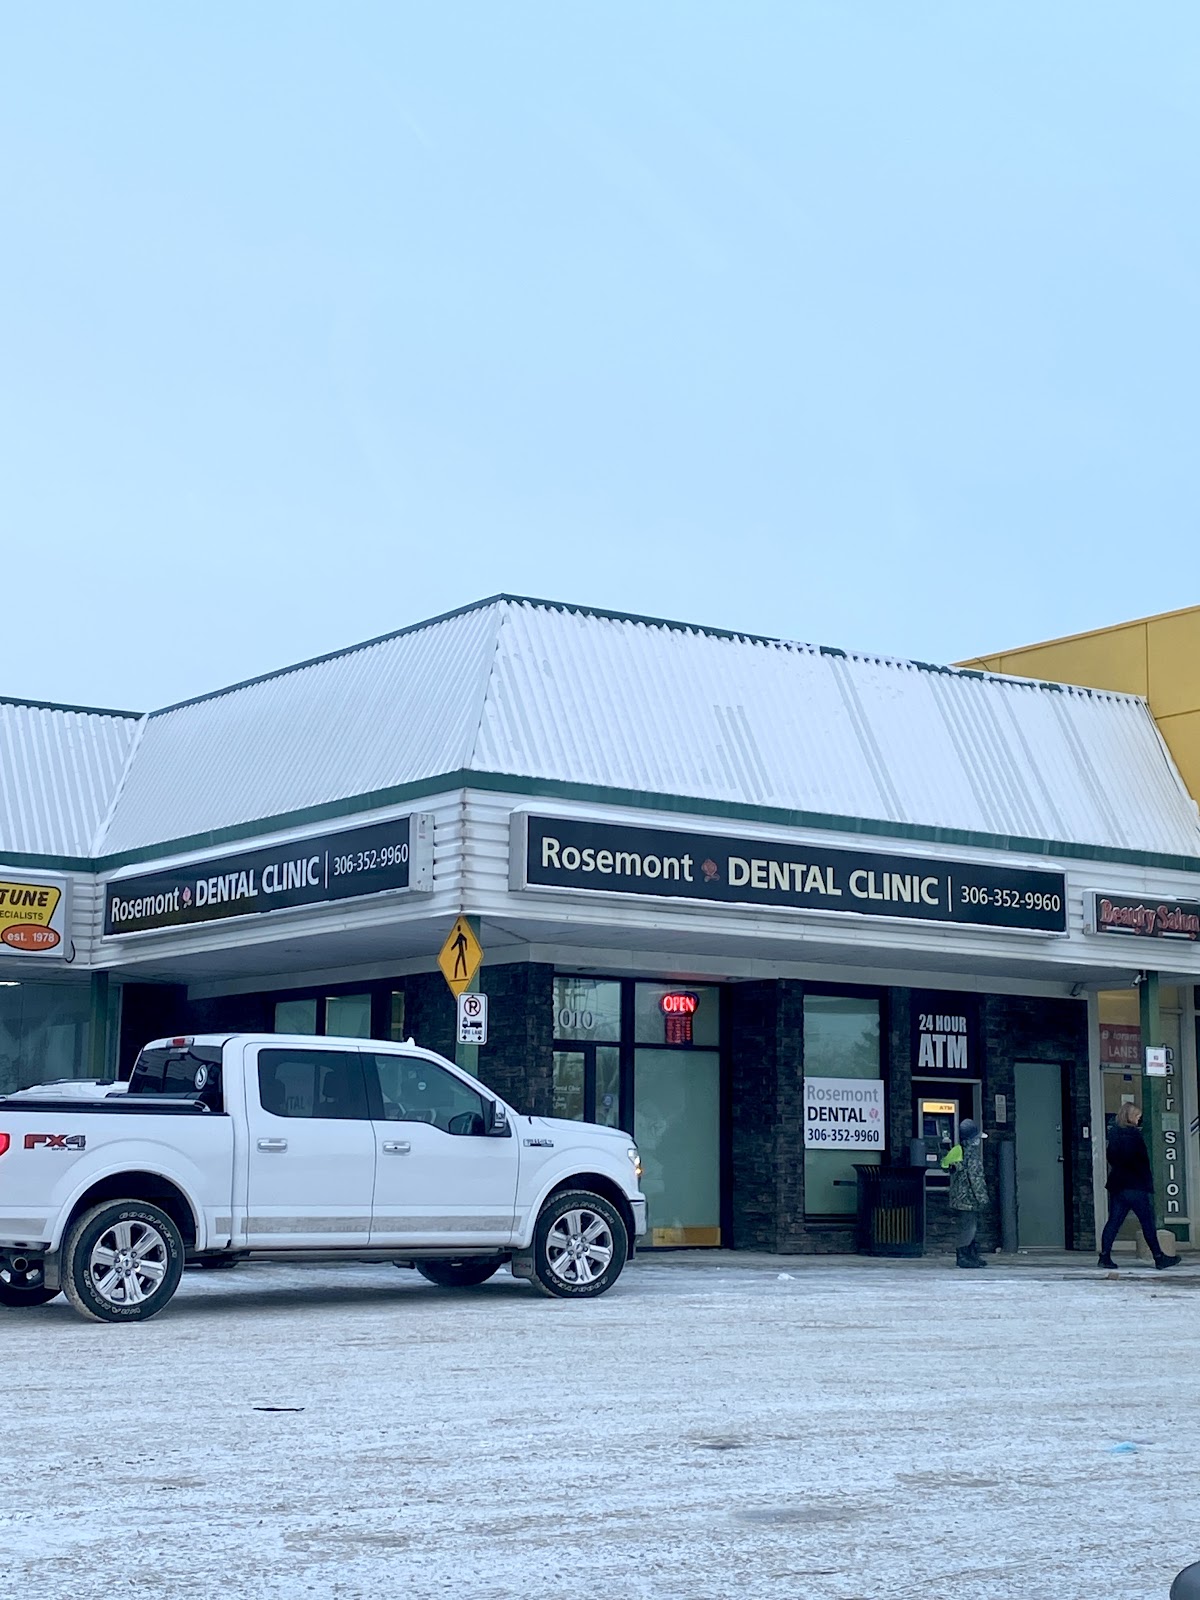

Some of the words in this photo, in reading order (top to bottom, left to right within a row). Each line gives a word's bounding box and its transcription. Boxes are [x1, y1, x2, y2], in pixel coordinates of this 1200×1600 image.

[111, 886, 180, 922] Rosemont
[195, 869, 259, 907] DENTAL
[262, 855, 320, 894] CLINIC
[333, 843, 409, 876] 306-352-9960
[542, 836, 694, 882] Rosemont
[728, 856, 842, 896] DENTAL
[849, 869, 939, 905] CLINIC
[961, 885, 1061, 912] 306-352-9960
[1100, 898, 1156, 934] Beauty
[7, 932, 27, 942] est.
[32, 932, 55, 943] 1978
[663, 995, 695, 1013] OPEN
[918, 1013, 934, 1031] 24
[935, 1014, 967, 1033] HOUR
[917, 1033, 968, 1069] ATM
[1108, 1045, 1138, 1059] LANES
[807, 1084, 879, 1103] Rosemont
[807, 1105, 867, 1123] DENTAL
[24, 1134, 87, 1149] FX4
[807, 1127, 880, 1142] 306-352-9960
[1164, 1130, 1179, 1213] salon
